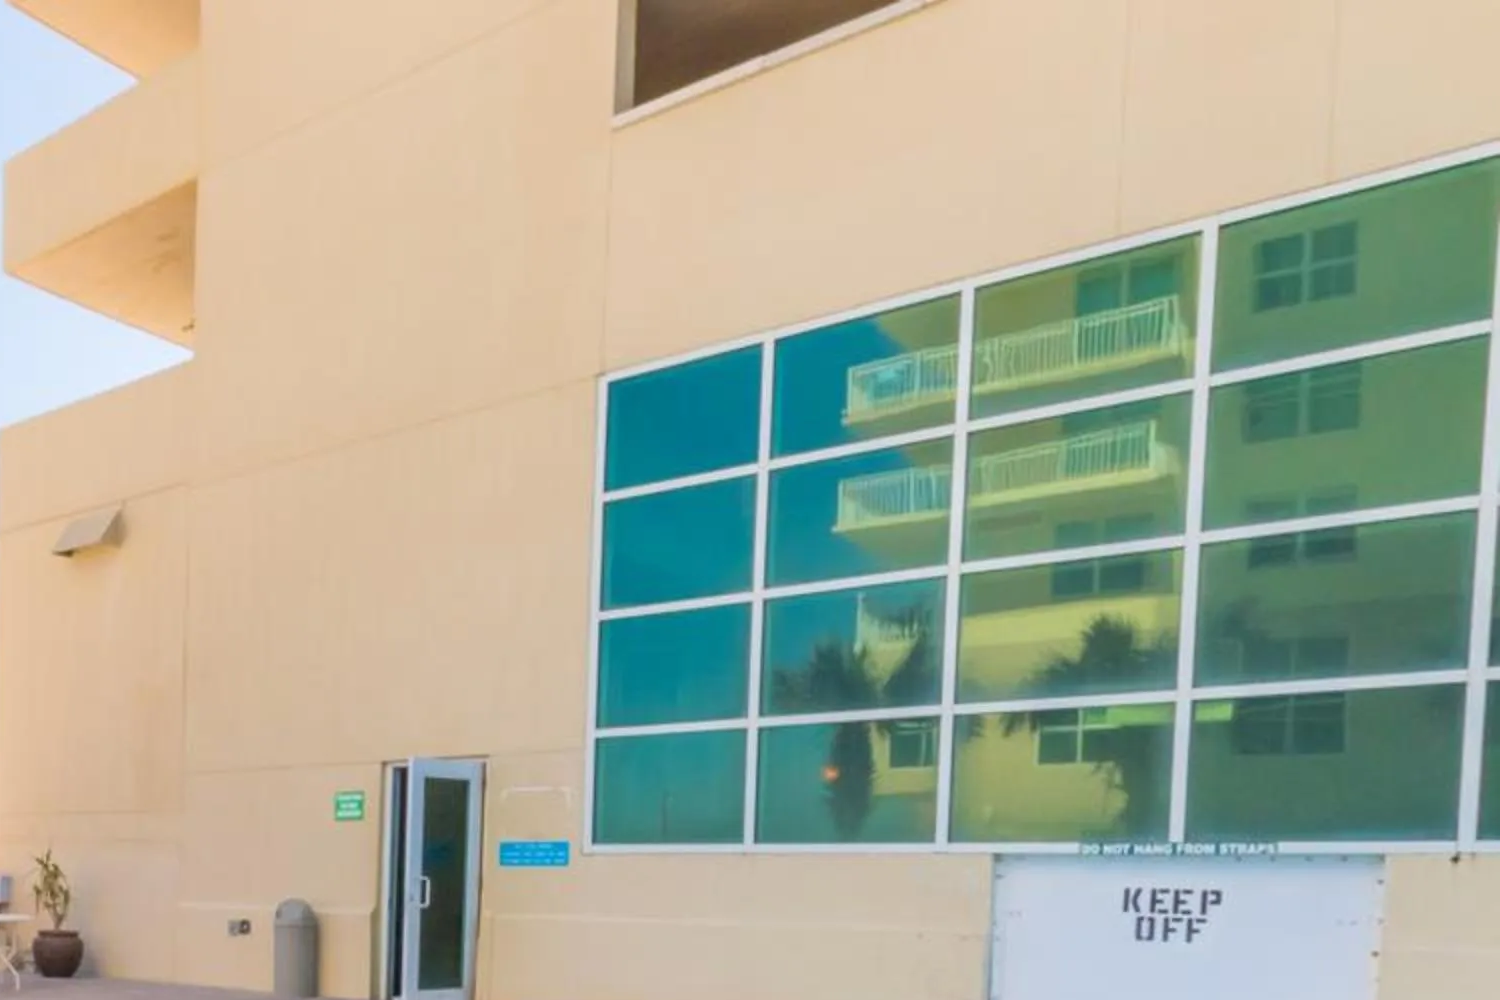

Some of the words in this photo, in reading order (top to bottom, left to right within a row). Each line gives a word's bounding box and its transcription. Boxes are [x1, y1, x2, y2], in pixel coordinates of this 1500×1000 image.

[1082, 843, 1100, 855] DO
[1103, 843, 1129, 855] NOT
[1133, 843, 1172, 855] HANG
[1176, 843, 1214, 855] FROM
[1220, 843, 1276, 855] STRAPS
[1122, 887, 1223, 915] KEEP
[1135, 916, 1207, 943] OFF
